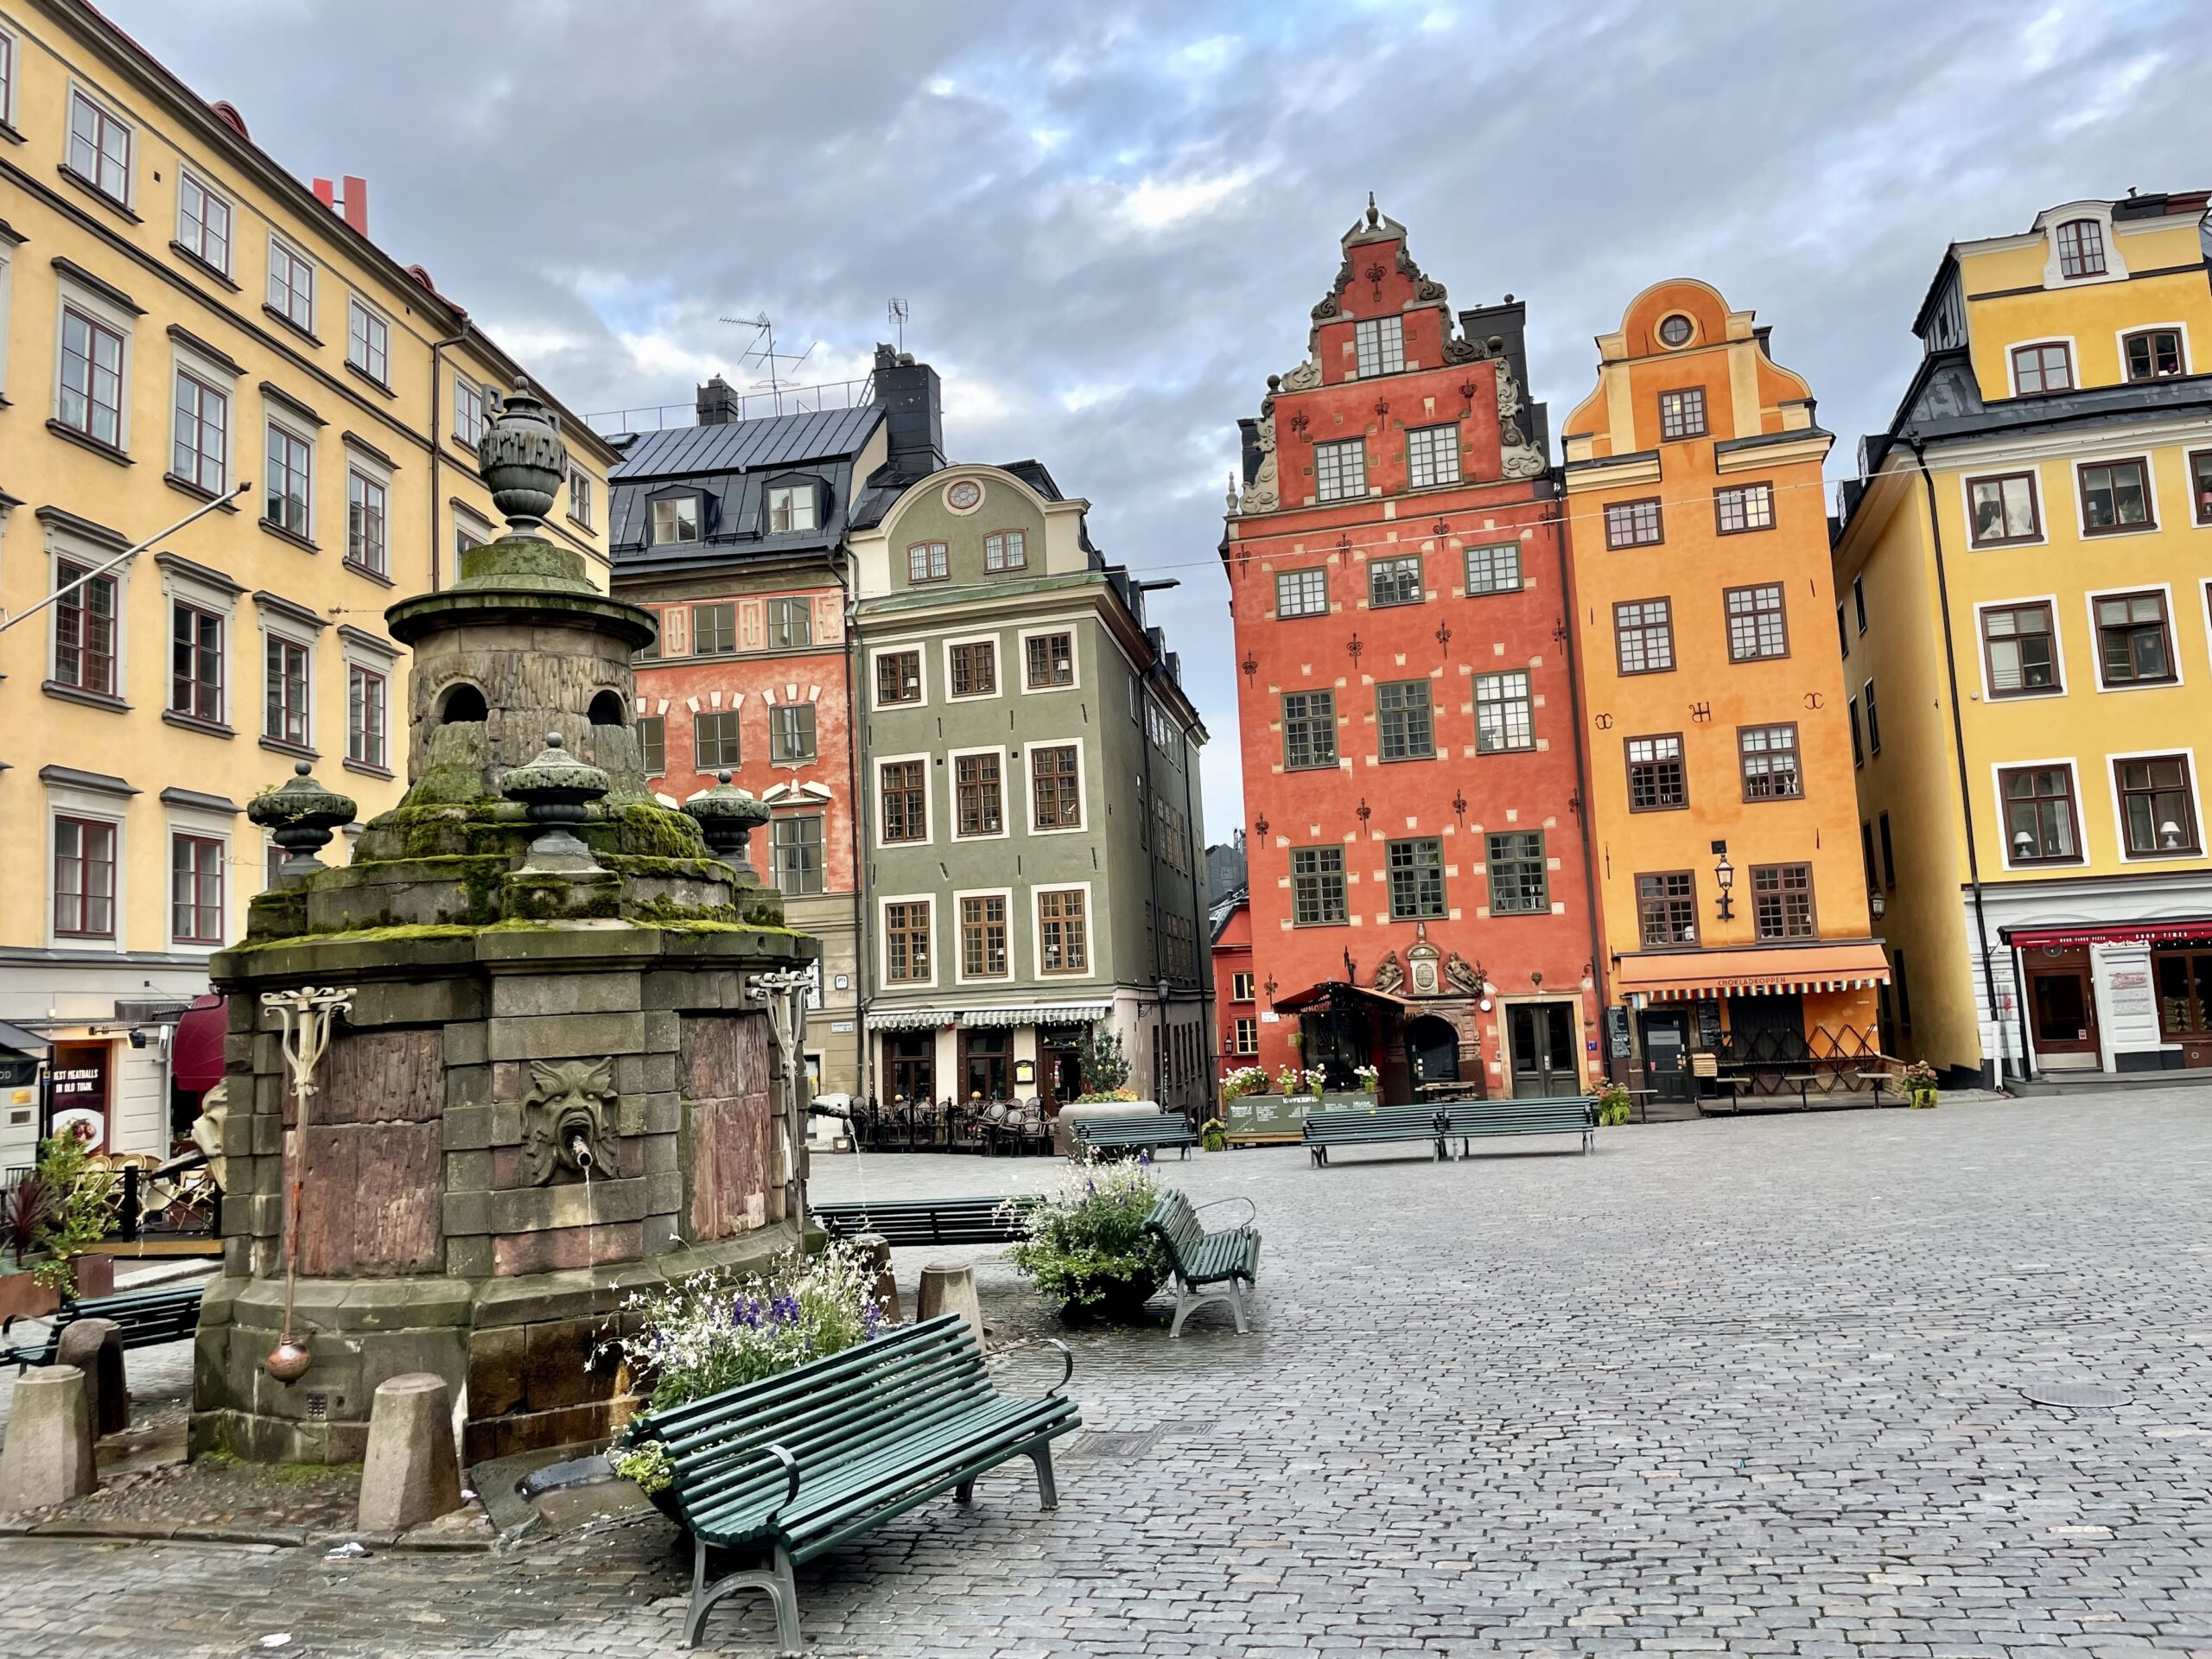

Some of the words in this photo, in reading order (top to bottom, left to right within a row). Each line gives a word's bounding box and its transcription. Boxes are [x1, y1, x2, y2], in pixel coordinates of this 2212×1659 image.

[1718, 976, 1786, 986] CHOKLADKOPPEN
[67, 1069, 99, 1079] MEATBALLS
[56, 1084, 63, 1093] IN
[65, 1083, 75, 1092] OLD
